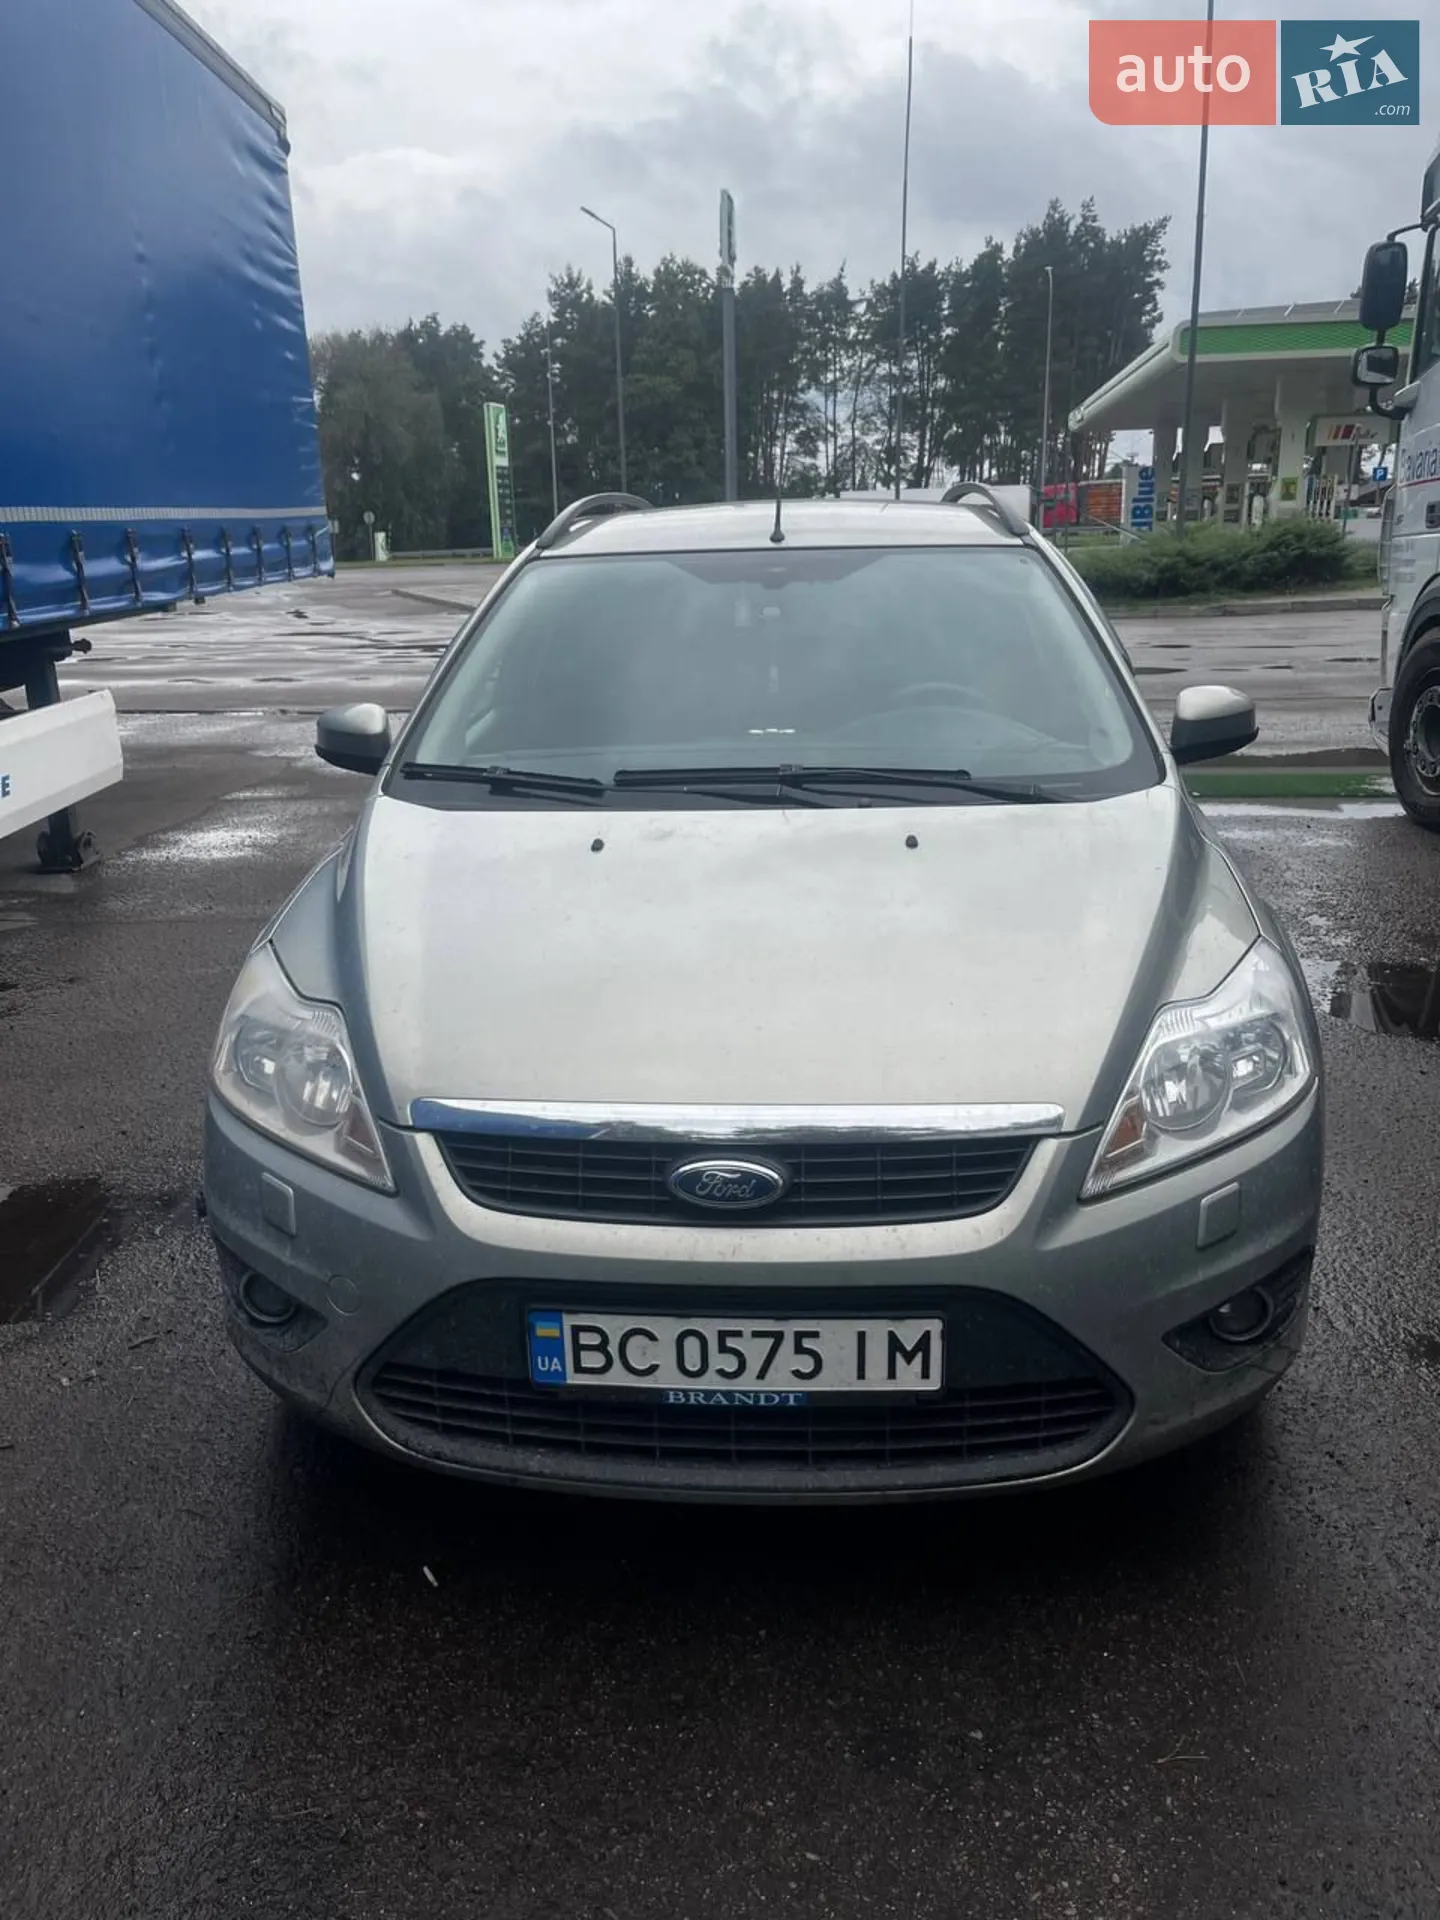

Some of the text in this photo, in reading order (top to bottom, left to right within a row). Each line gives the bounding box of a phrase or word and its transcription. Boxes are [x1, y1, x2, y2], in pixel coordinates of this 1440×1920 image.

[695, 1170, 757, 1198] Ford
[570, 1323, 931, 1381] BC 0575 IM
[537, 1355, 562, 1373] UA
[667, 1390, 803, 1406] BRANDT
